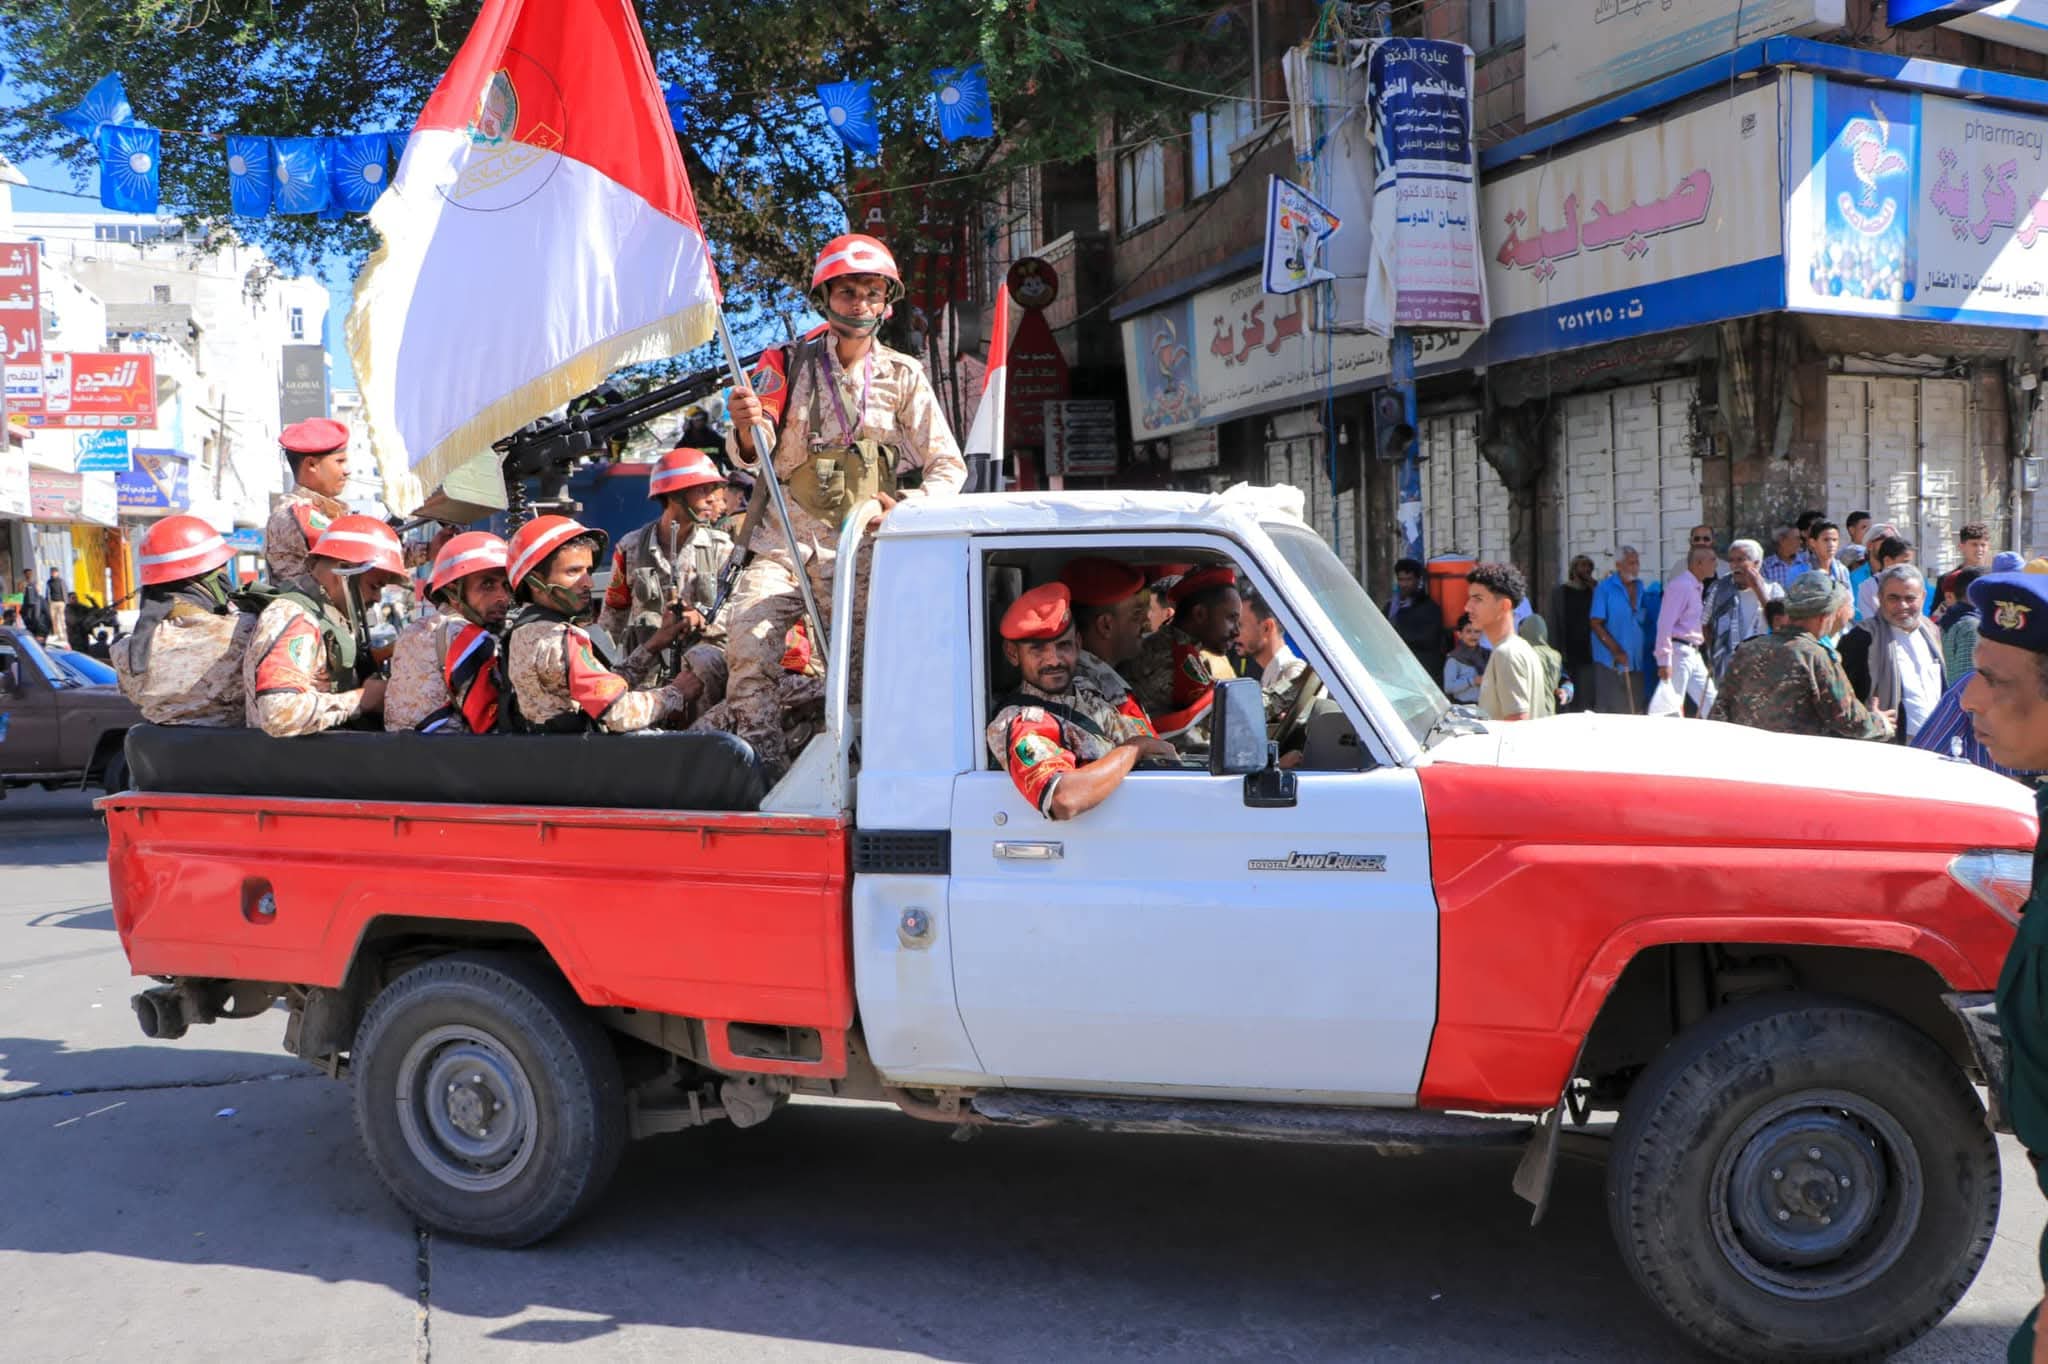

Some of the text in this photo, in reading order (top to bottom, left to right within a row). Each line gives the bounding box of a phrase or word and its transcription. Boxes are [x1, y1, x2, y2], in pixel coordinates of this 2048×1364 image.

[1420, 47, 1449, 66] عيادة
[1964, 119, 2043, 160] pharmacy
[1495, 168, 1714, 282] صيدلية
[74, 360, 140, 393] النجم
